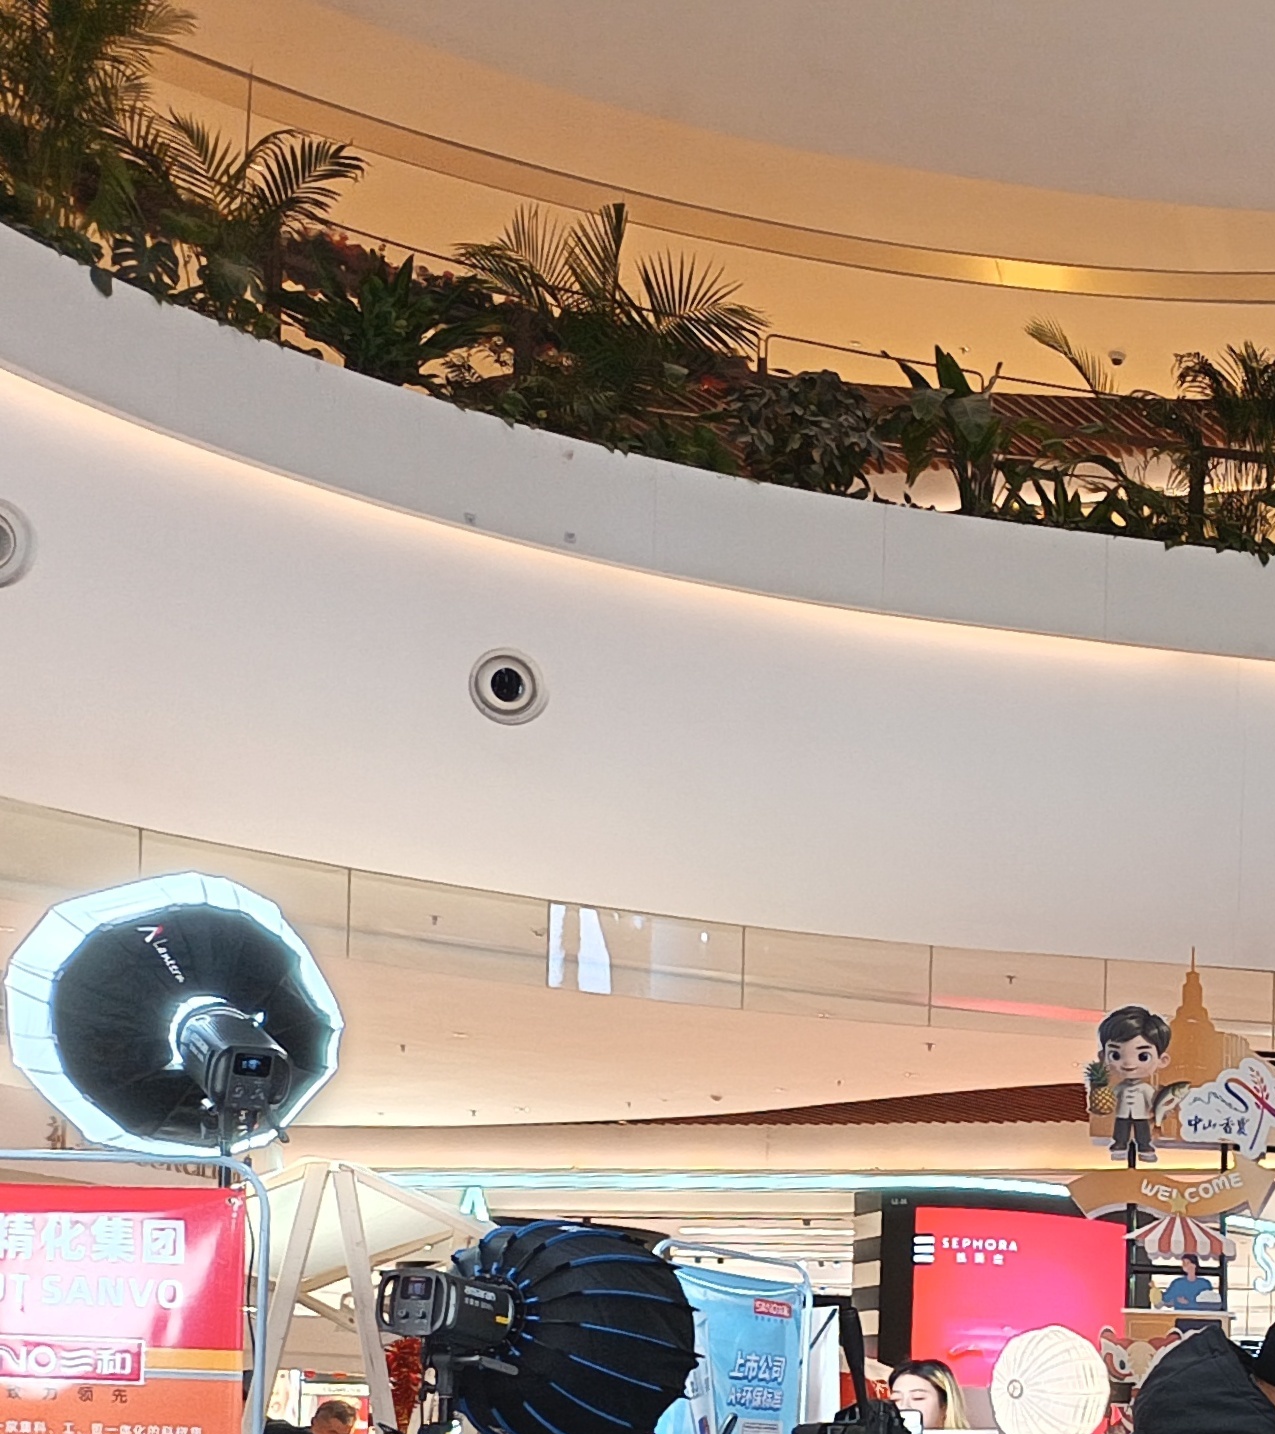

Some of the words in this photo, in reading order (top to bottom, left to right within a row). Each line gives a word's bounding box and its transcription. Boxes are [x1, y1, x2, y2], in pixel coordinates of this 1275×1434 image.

[942, 1236, 1018, 1252] SEPHORA
[41, 1274, 184, 1310] SANVO
[729, 1351, 786, 1385] 上市公司
